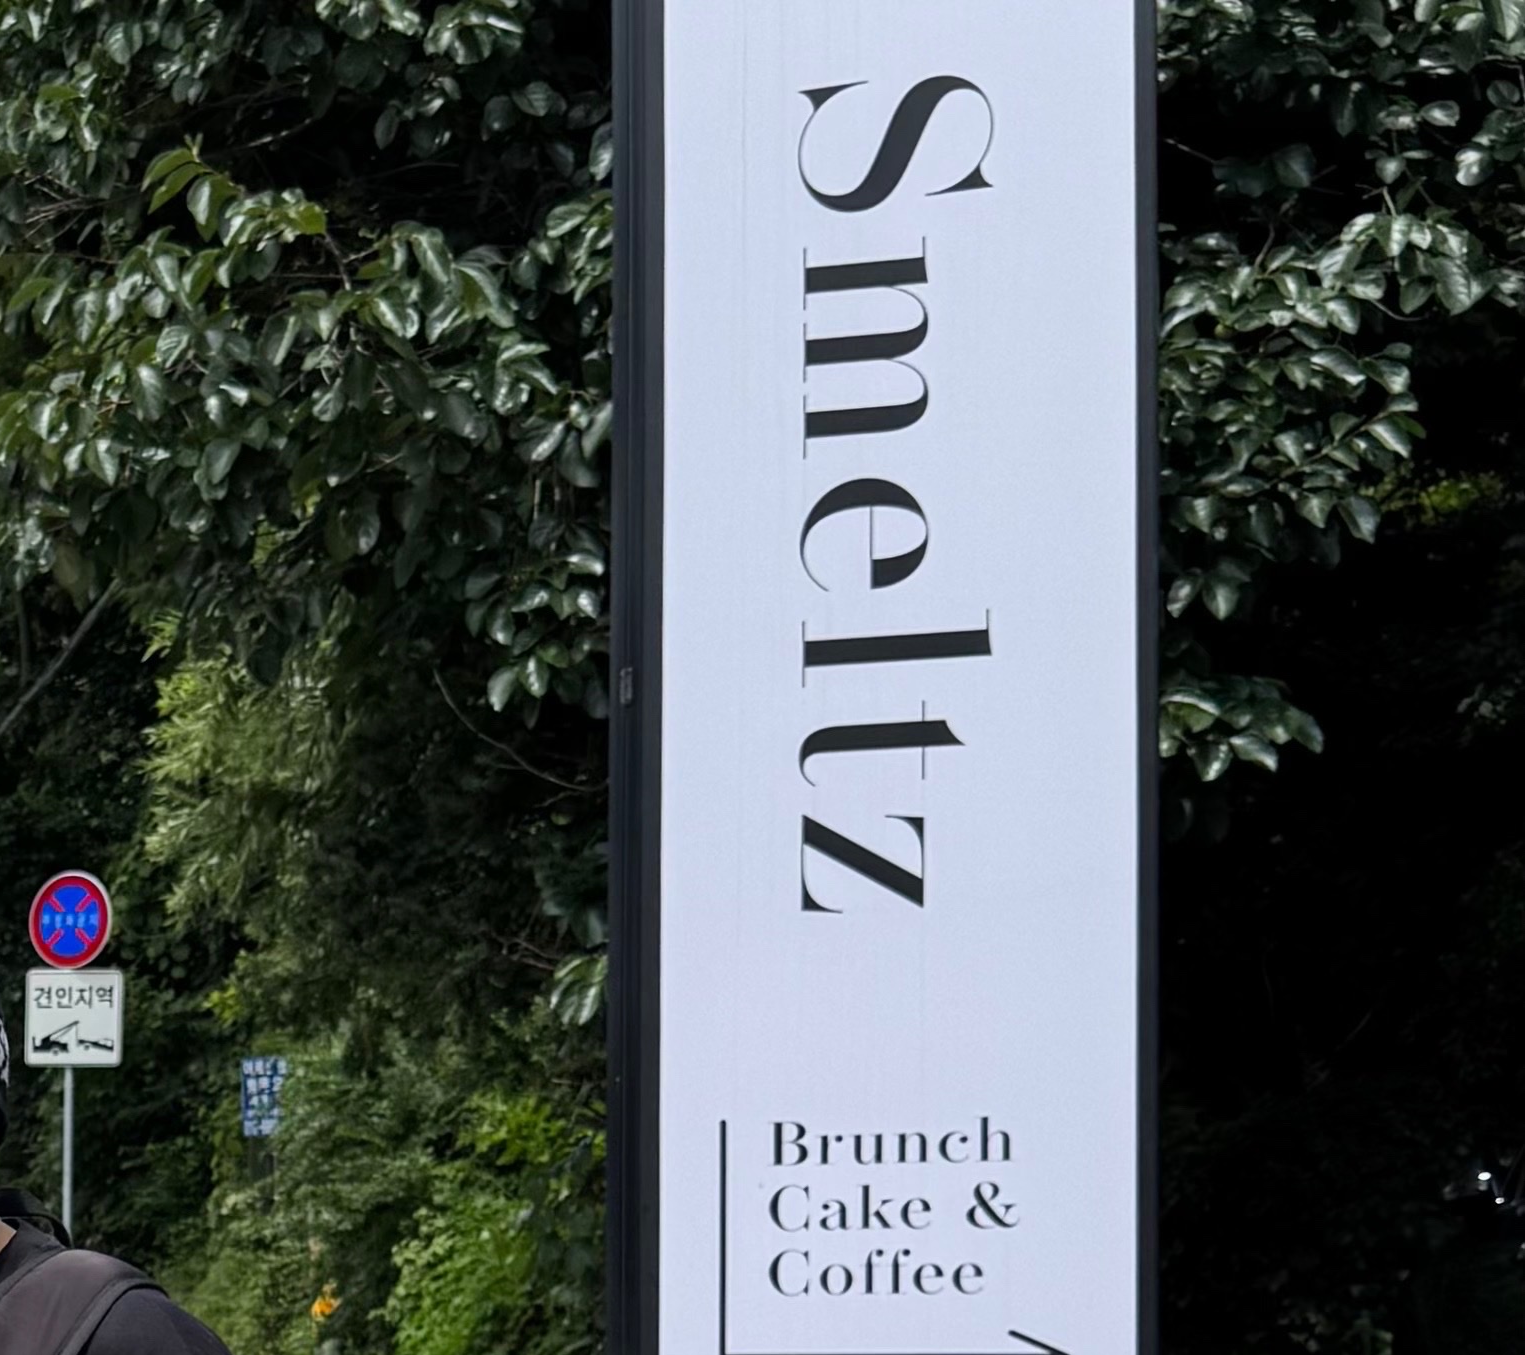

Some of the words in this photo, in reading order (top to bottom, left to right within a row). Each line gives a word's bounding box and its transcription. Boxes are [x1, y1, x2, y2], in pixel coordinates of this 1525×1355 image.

[798, 74, 995, 915] Smeltz
[33, 984, 114, 1010] 견인지역
[767, 1116, 1015, 1167] Brunch
[768, 1183, 933, 1233] Cake
[965, 1180, 1021, 1230] &
[768, 1248, 985, 1298] Coffee
